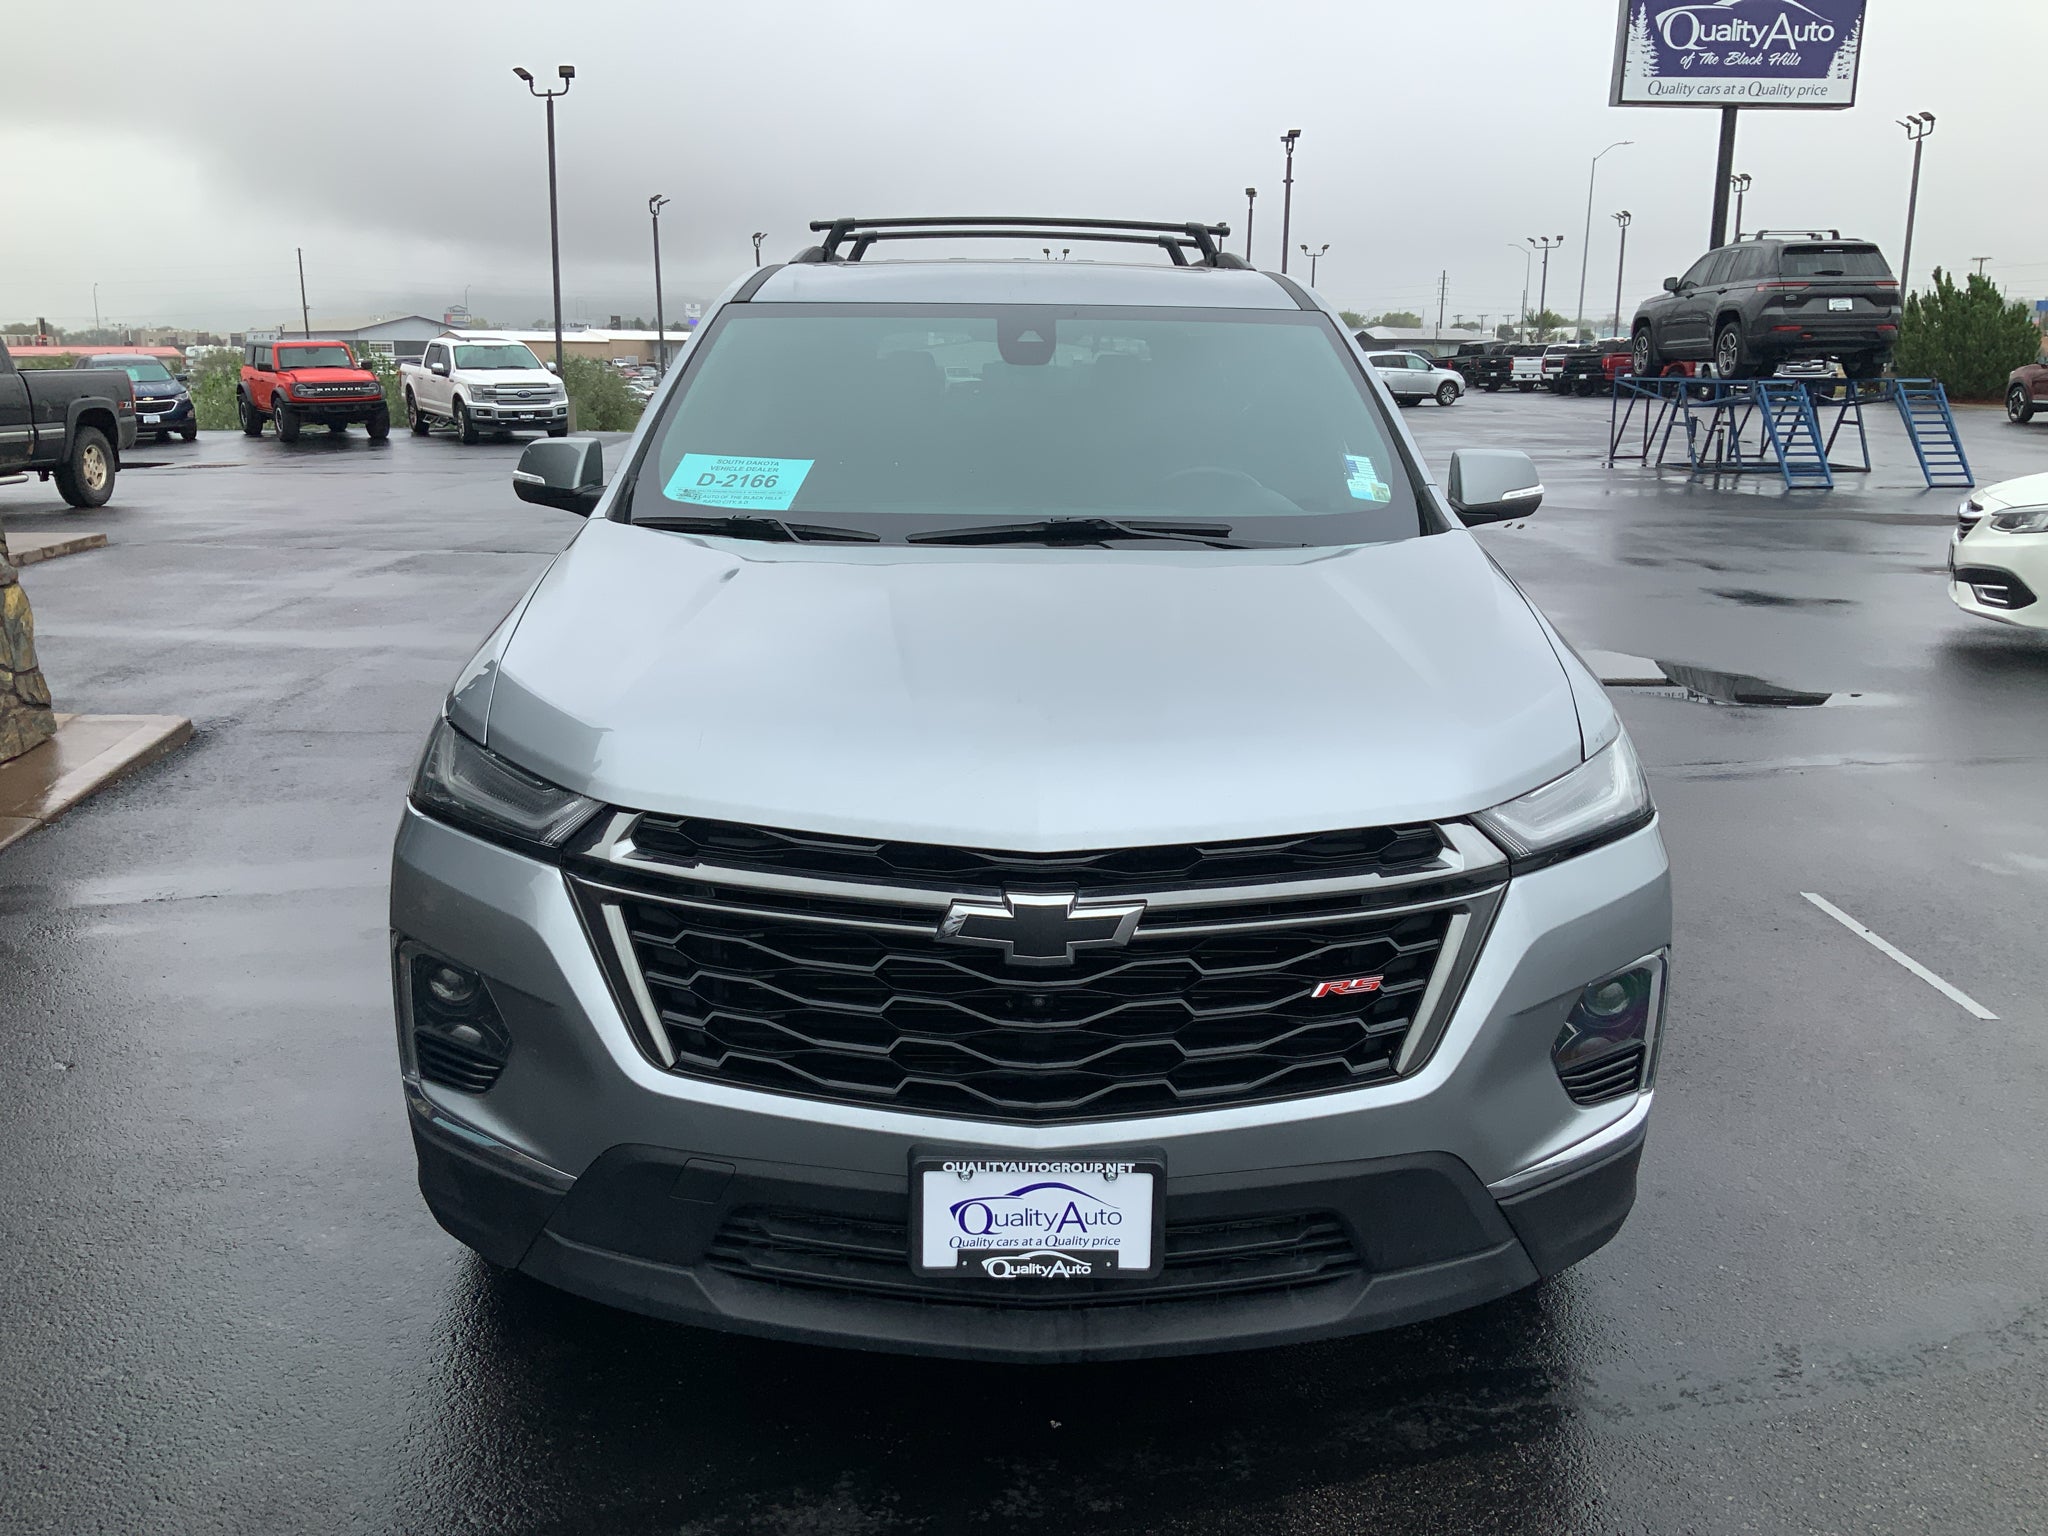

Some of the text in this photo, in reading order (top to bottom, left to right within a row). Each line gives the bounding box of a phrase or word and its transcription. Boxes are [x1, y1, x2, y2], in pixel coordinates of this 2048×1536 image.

[1663, 11, 1835, 50] QualityAuto
[1680, 52, 1802, 69] of The Black Hills
[1648, 80, 1828, 98] Quality cars at a Quality price
[696, 473, 779, 488] D-2166
[1311, 975, 1384, 998] RS
[942, 1161, 1135, 1174] QUALITYAUTOGROUP.NET
[958, 1201, 1122, 1235] QualityAuto
[949, 1236, 994, 1249] Quality
[996, 1239, 1019, 1247] cars
[1021, 1238, 1034, 1247] at
[1045, 1234, 1089, 1248] Quality
[1092, 1236, 1120, 1248] price
[987, 1259, 1092, 1278] QualityAuto
